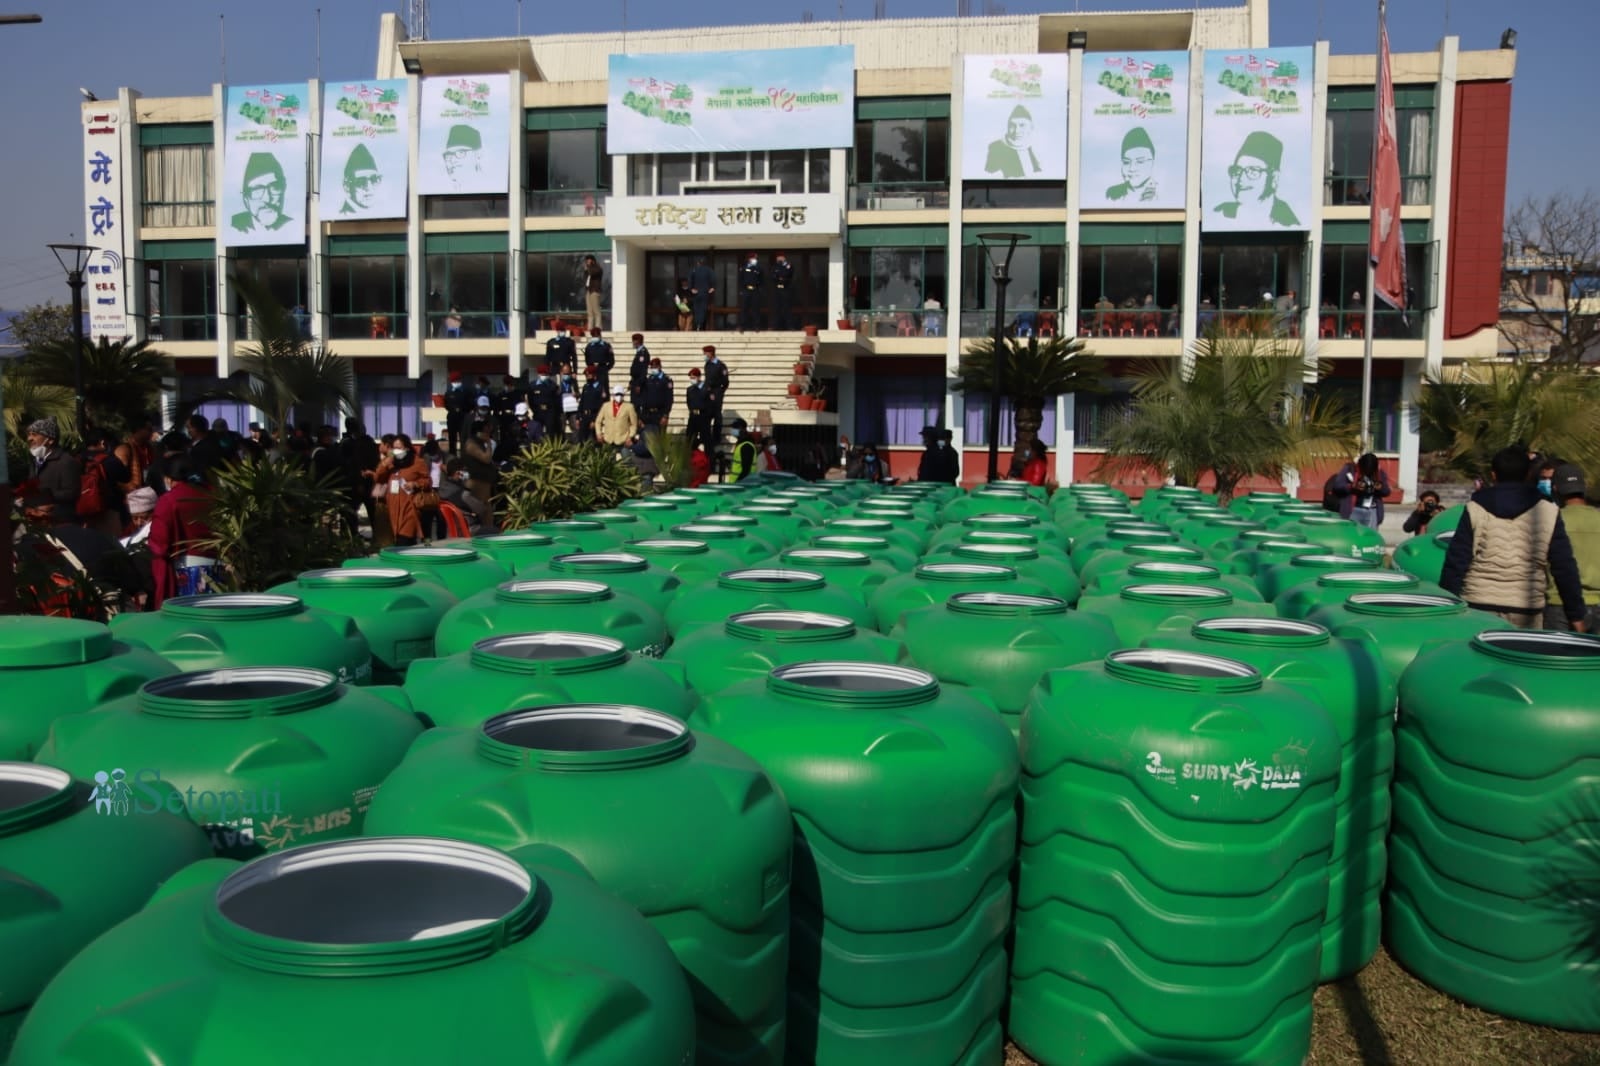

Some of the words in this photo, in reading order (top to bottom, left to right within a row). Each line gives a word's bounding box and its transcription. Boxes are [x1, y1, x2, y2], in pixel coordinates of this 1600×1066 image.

[717, 206, 762, 225] सभा
[773, 206, 808, 229] गृह
[1182, 762, 1231, 781] SURY
